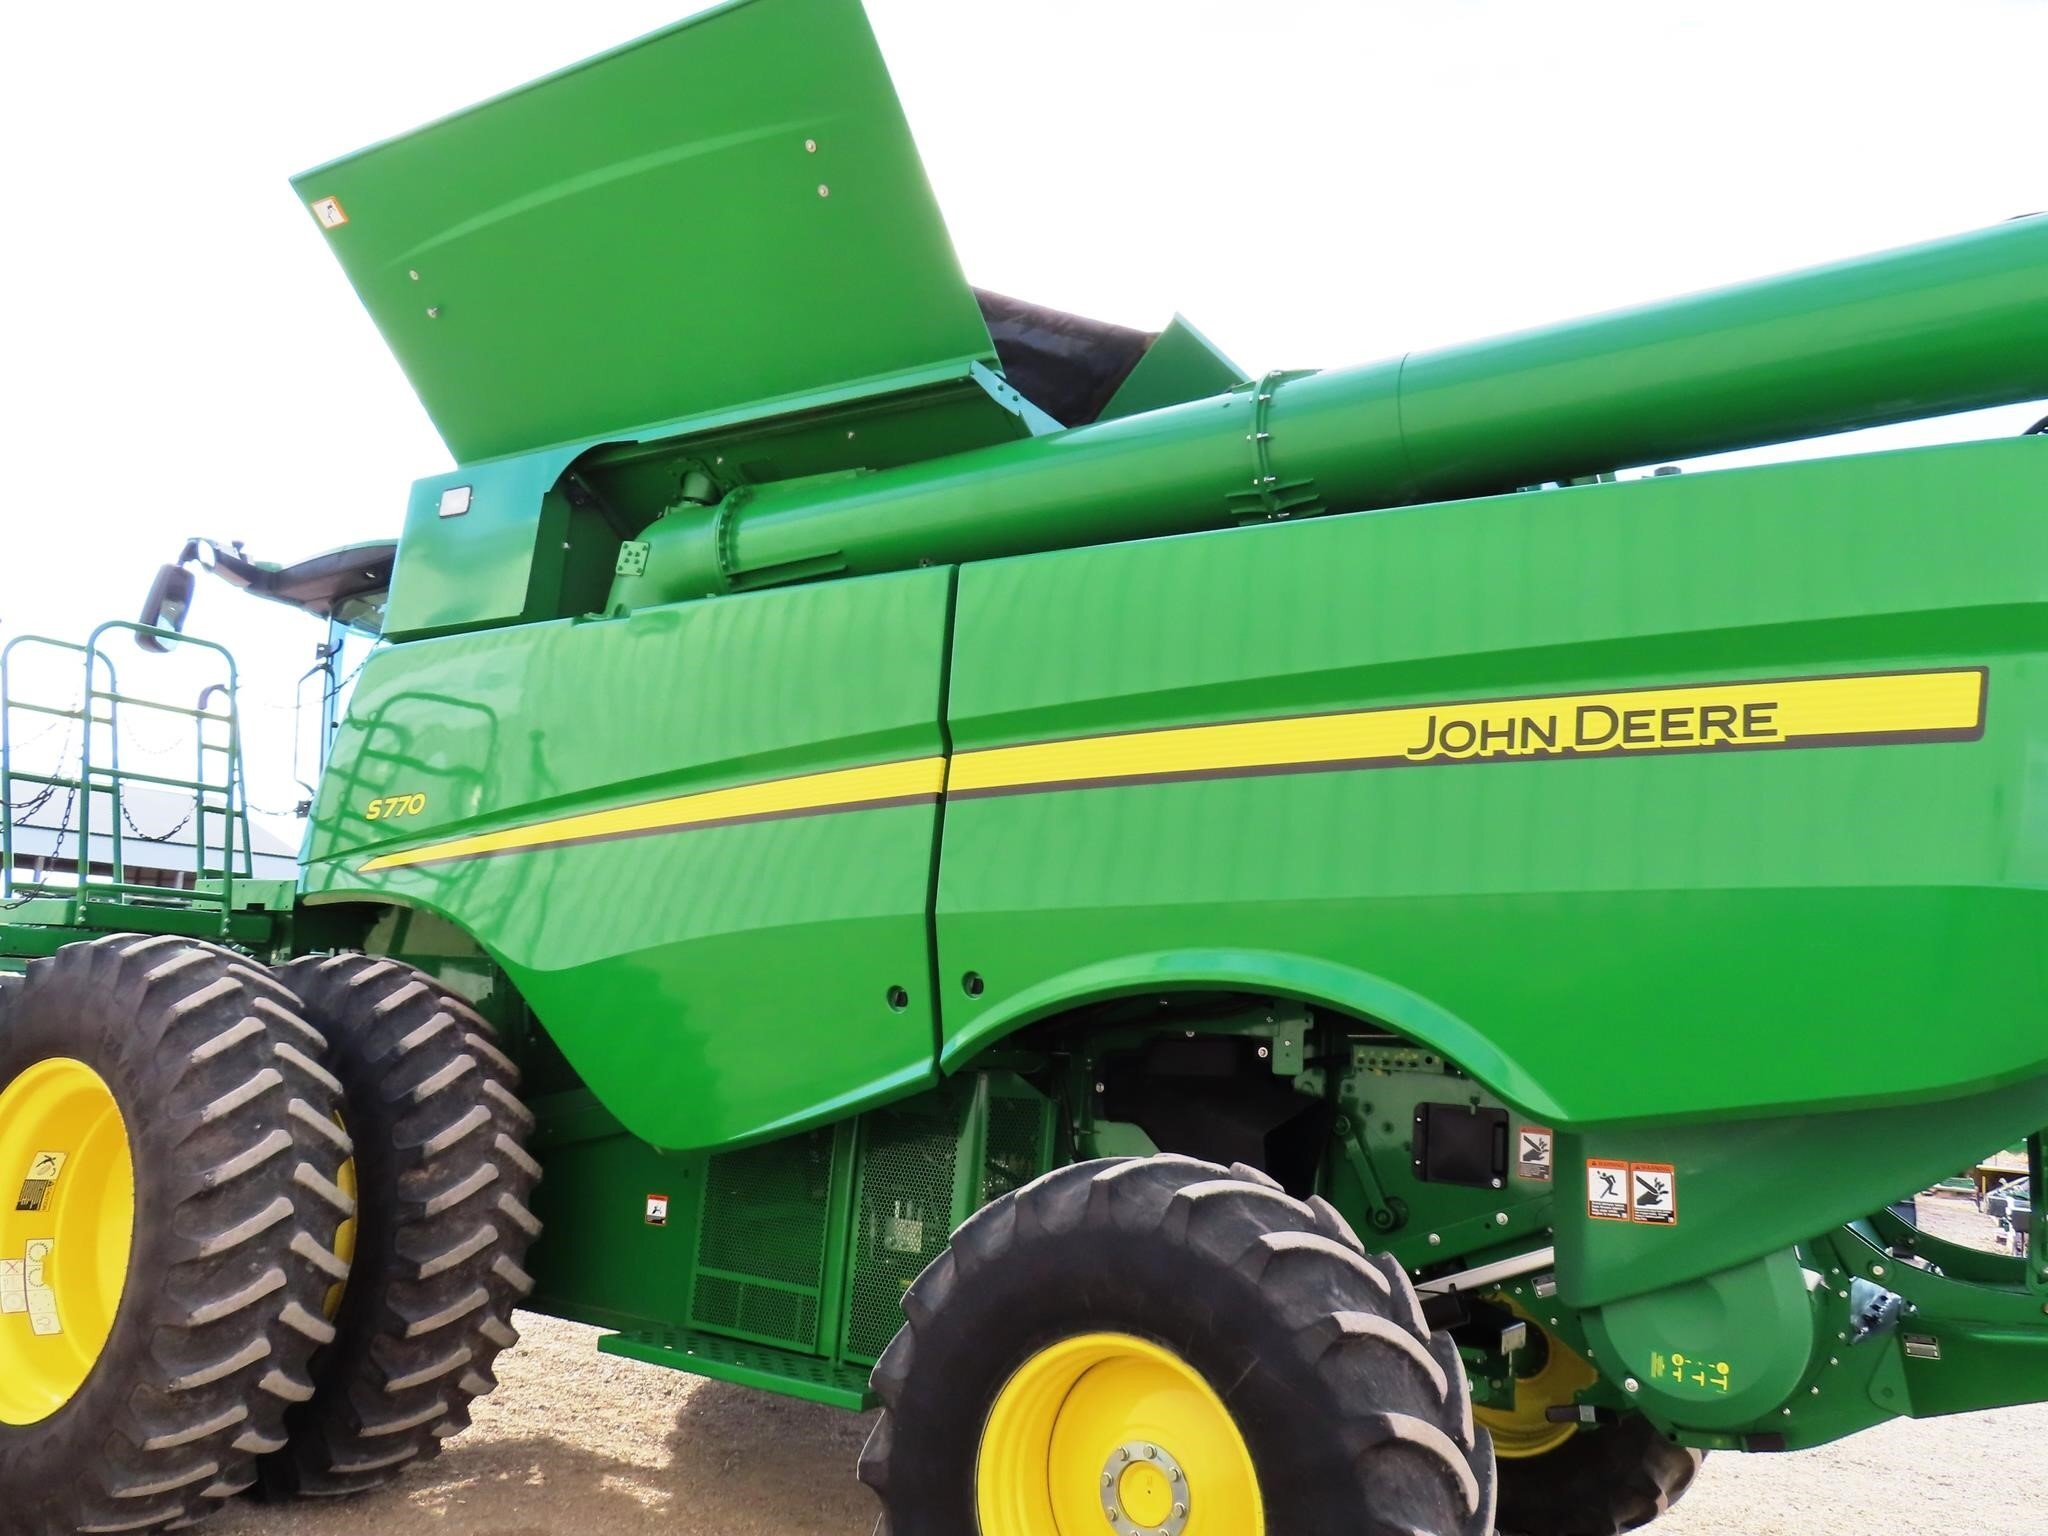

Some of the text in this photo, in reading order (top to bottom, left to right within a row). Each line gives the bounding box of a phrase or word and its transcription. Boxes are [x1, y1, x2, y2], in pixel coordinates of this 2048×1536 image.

[1406, 702, 1778, 755] JOHN DEERE
[366, 793, 426, 820] S770
